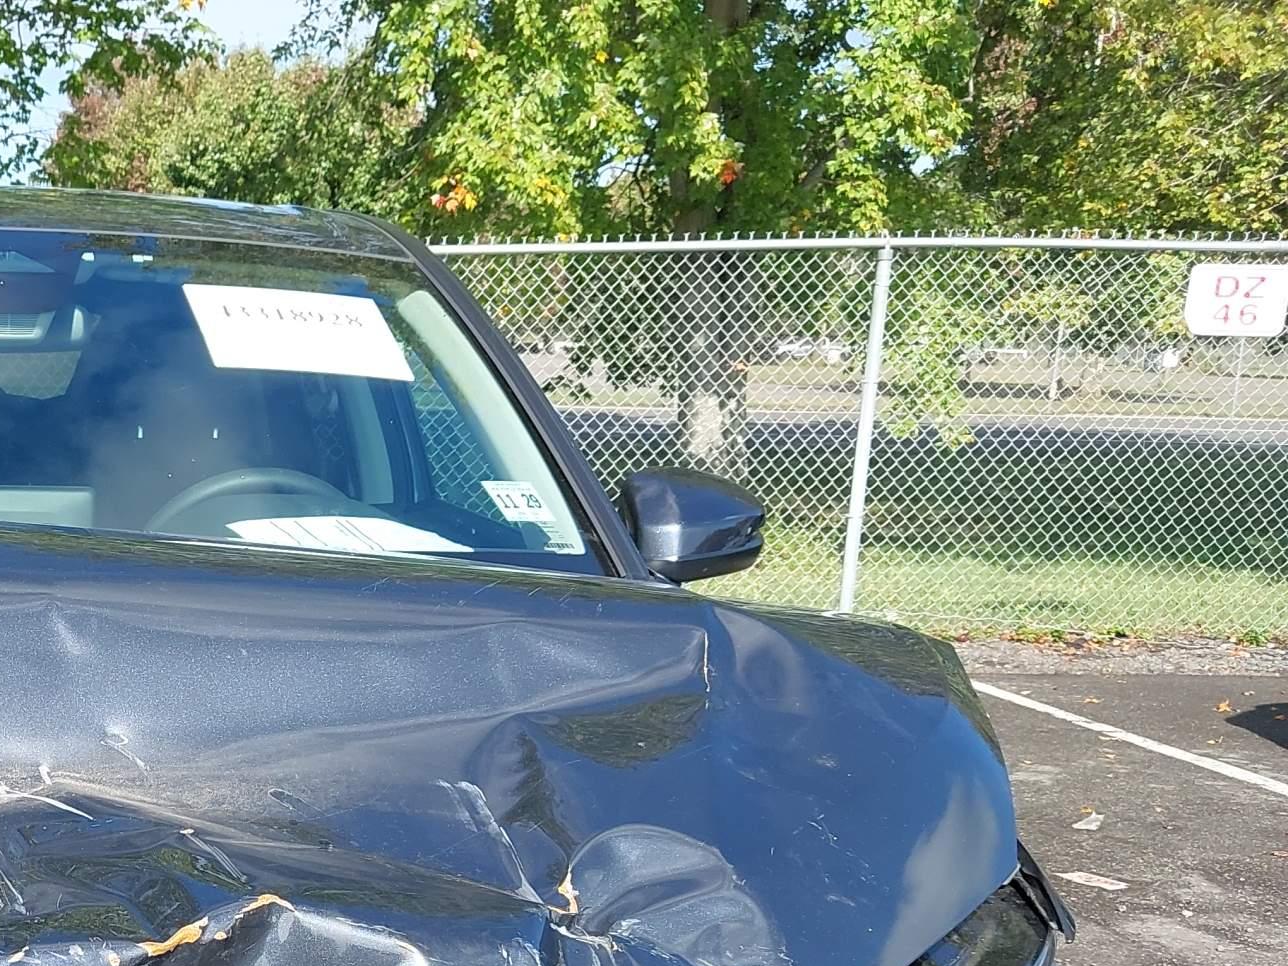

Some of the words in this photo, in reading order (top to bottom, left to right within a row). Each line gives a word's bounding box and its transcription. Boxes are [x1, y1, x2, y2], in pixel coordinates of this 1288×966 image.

[1214, 275, 1267, 299] DZ
[1212, 303, 1258, 326] 46
[496, 493, 520, 509] 11
[520, 493, 542, 509] 29
